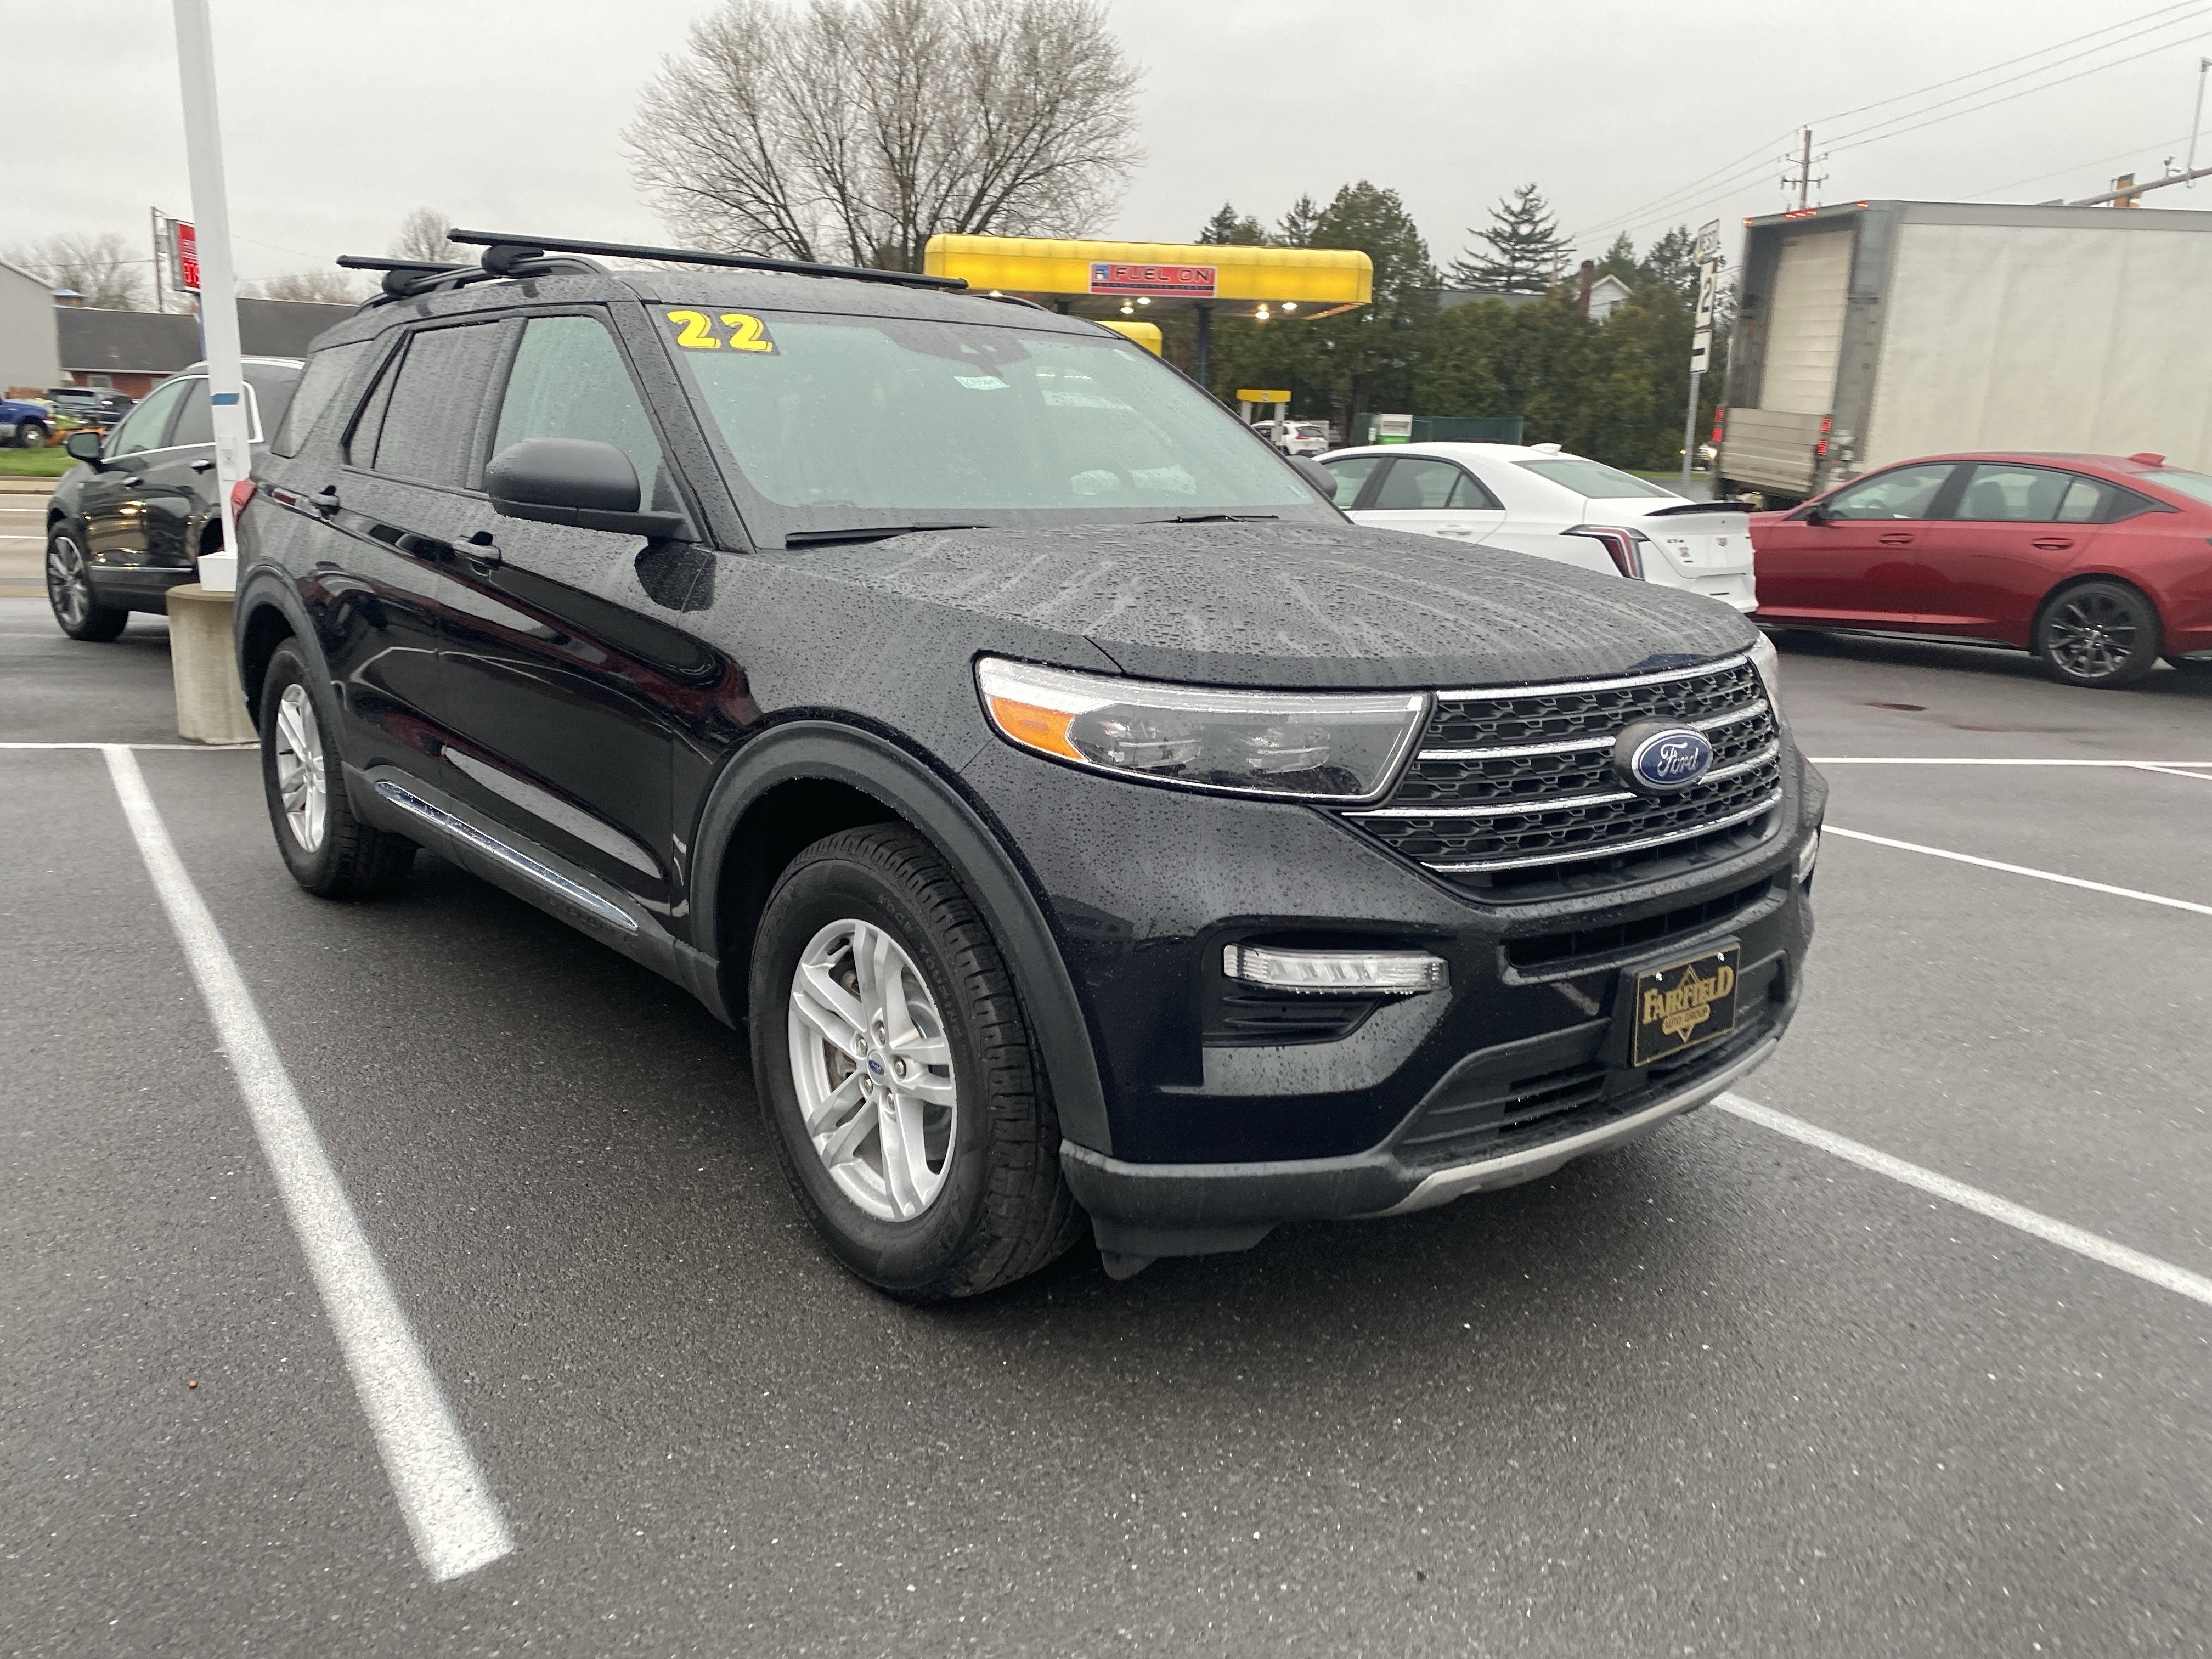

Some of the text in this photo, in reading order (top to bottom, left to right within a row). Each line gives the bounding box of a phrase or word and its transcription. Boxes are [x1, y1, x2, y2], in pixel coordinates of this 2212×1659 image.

[1114, 266, 1212, 283] FUEL ON
[667, 310, 773, 352] 22
[1657, 742, 1699, 777] Ford
[1643, 965, 1734, 1025] FAIRFIELD
[1664, 1007, 1708, 1029] AUTO GROUP
